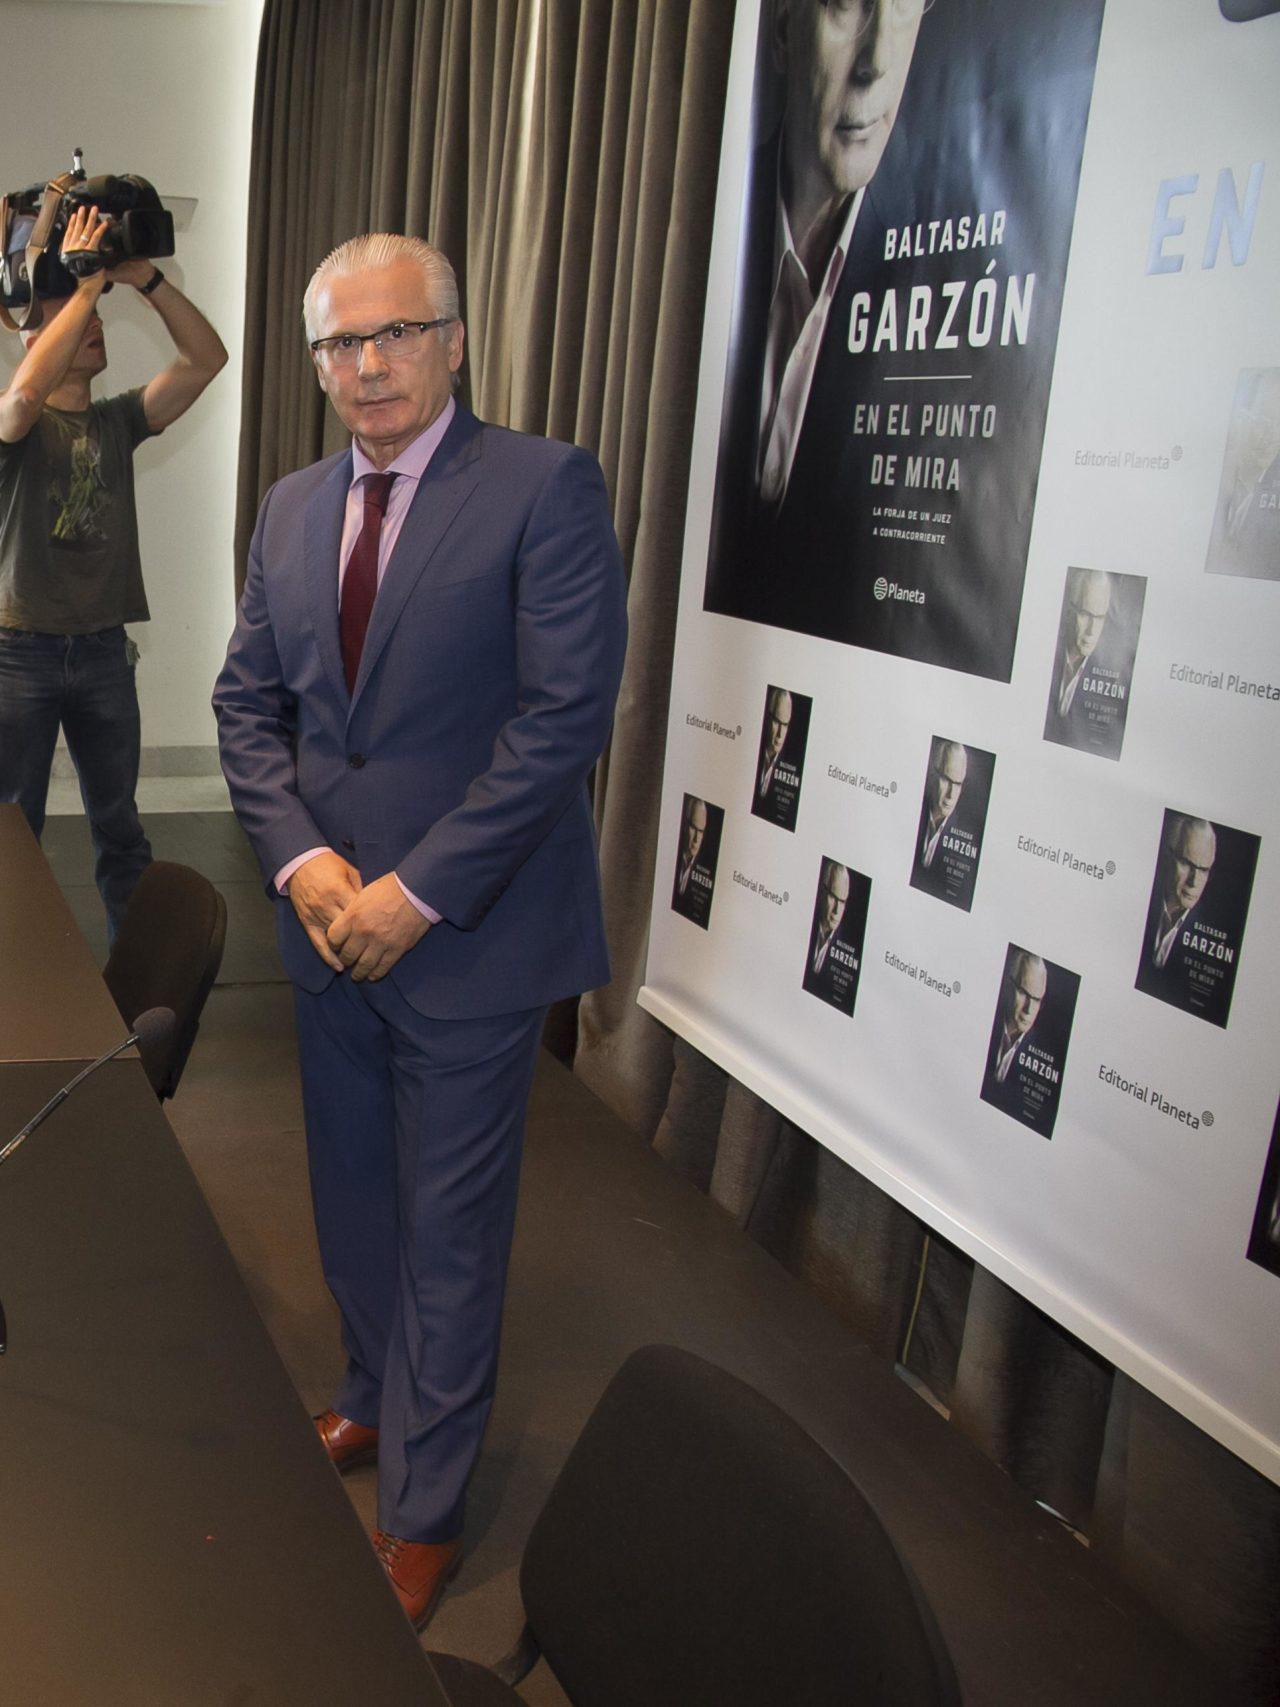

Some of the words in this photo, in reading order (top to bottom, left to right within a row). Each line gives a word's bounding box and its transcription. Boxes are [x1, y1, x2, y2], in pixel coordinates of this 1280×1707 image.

[1145, 160, 1265, 276] EN
[884, 210, 1007, 261] BALTASAR
[847, 258, 1036, 354] GARZÓN
[853, 404, 880, 435] EN
[886, 404, 911, 436] EL
[920, 404, 997, 438] PUNTO
[870, 454, 898, 486] DE
[904, 455, 960, 491] MIRA
[1074, 449, 1121, 468] Editorial
[1123, 450, 1170, 470] Planeta
[872, 506, 882, 516] LA
[883, 507, 906, 519] FORJA
[908, 510, 918, 521] DE
[920, 511, 930, 521] UN
[932, 513, 952, 524] JUEZ
[880, 527, 946, 545] CONTRACORRIENTE
[888, 583, 926, 605] Planeta
[1170, 663, 1224, 690] Editorial
[1226, 674, 1280, 701] Planeta
[686, 713, 712, 732] Editorial
[713, 722, 736, 741] Planeta
[827, 764, 858, 787] Editorial
[859, 776, 890, 798] Planeta
[942, 835, 978, 860] GARZÓN
[1017, 835, 1061, 864] Editorial
[1062, 851, 1105, 880] Planeta
[733, 870, 758, 892] Editorial
[758, 883, 783, 906] Planeta
[1182, 930, 1234, 963] GARZÓN
[885, 951, 918, 980] Editorial
[919, 969, 952, 998] Planeta
[1018, 1052, 1059, 1084] GARZÓN
[1099, 1064, 1149, 1103] Editorial
[1150, 1091, 1200, 1130] Planeta
